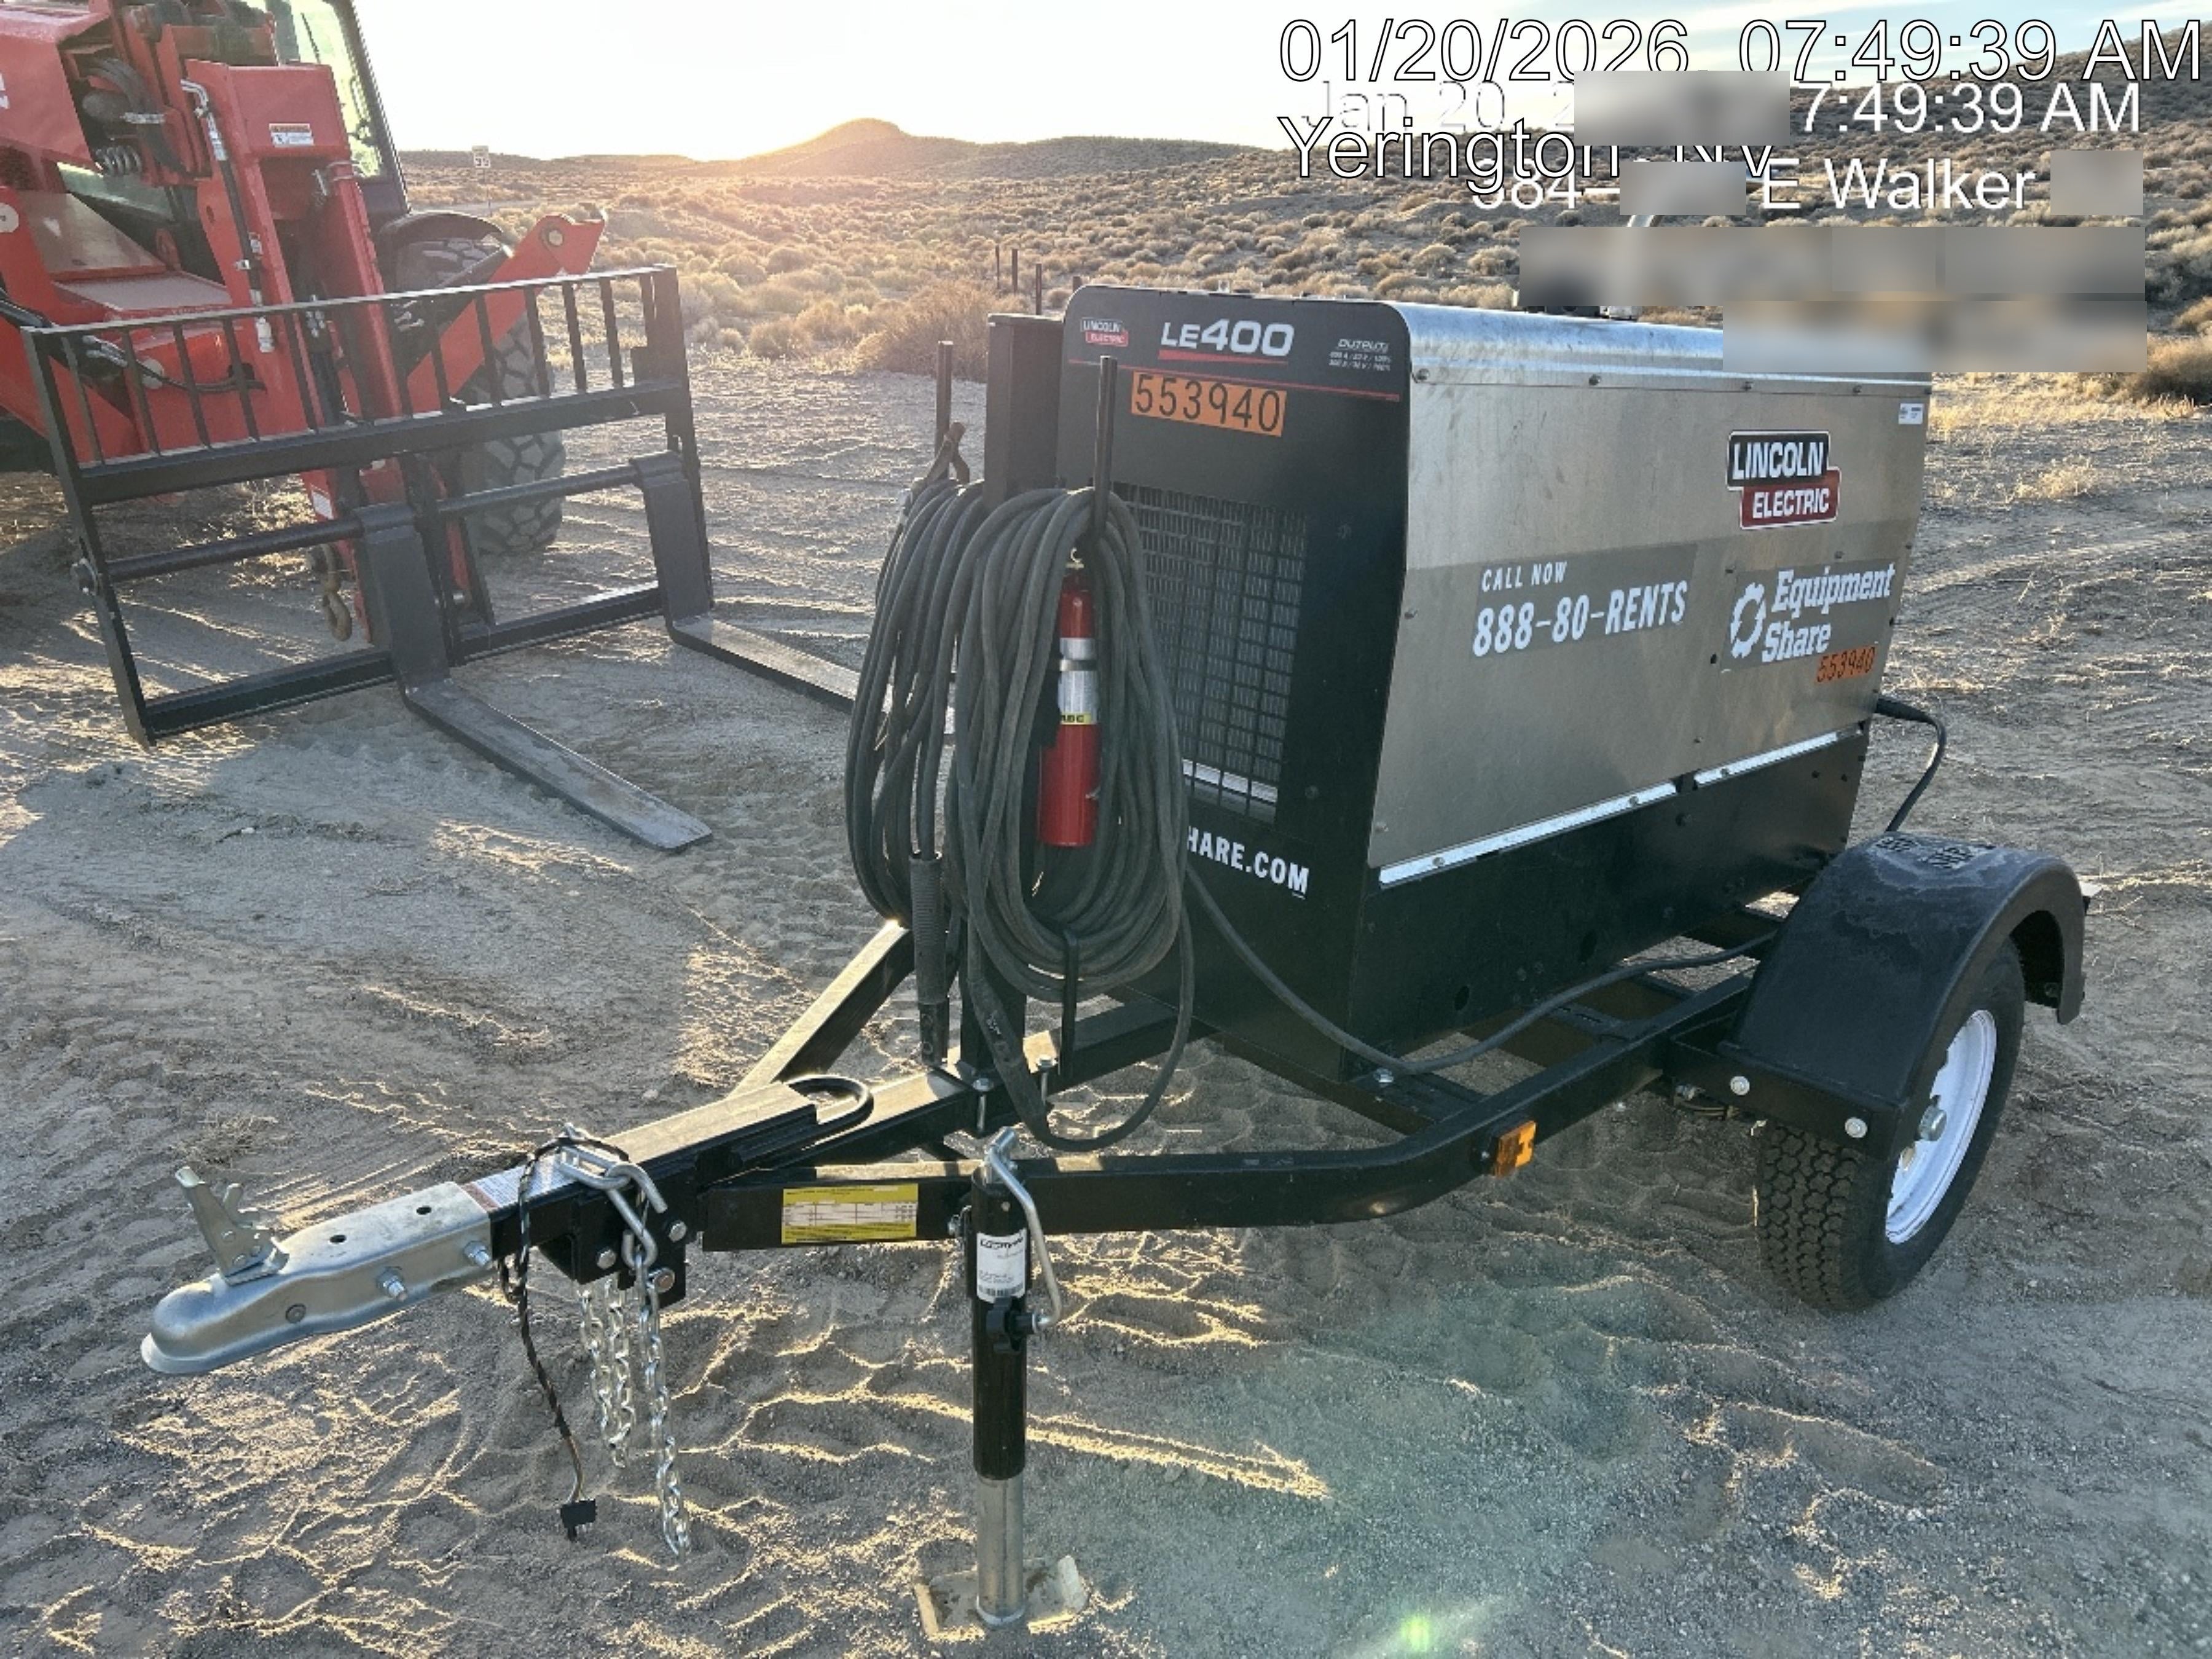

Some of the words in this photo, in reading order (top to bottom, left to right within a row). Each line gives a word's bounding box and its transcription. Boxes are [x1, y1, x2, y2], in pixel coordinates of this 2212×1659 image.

[1160, 318, 1295, 357] LE400
[1135, 374, 1281, 433] 553940
[1732, 441, 1824, 480] LINCOLN
[1752, 487, 1830, 519] ELECTRIC
[1481, 565, 1523, 592] CALL
[1531, 560, 1567, 586] NOW
[1771, 562, 1896, 619] Equipment
[1472, 580, 1688, 657] 888-80-RENTS
[1762, 620, 1832, 663] Share
[1816, 646, 1876, 683] 553940
